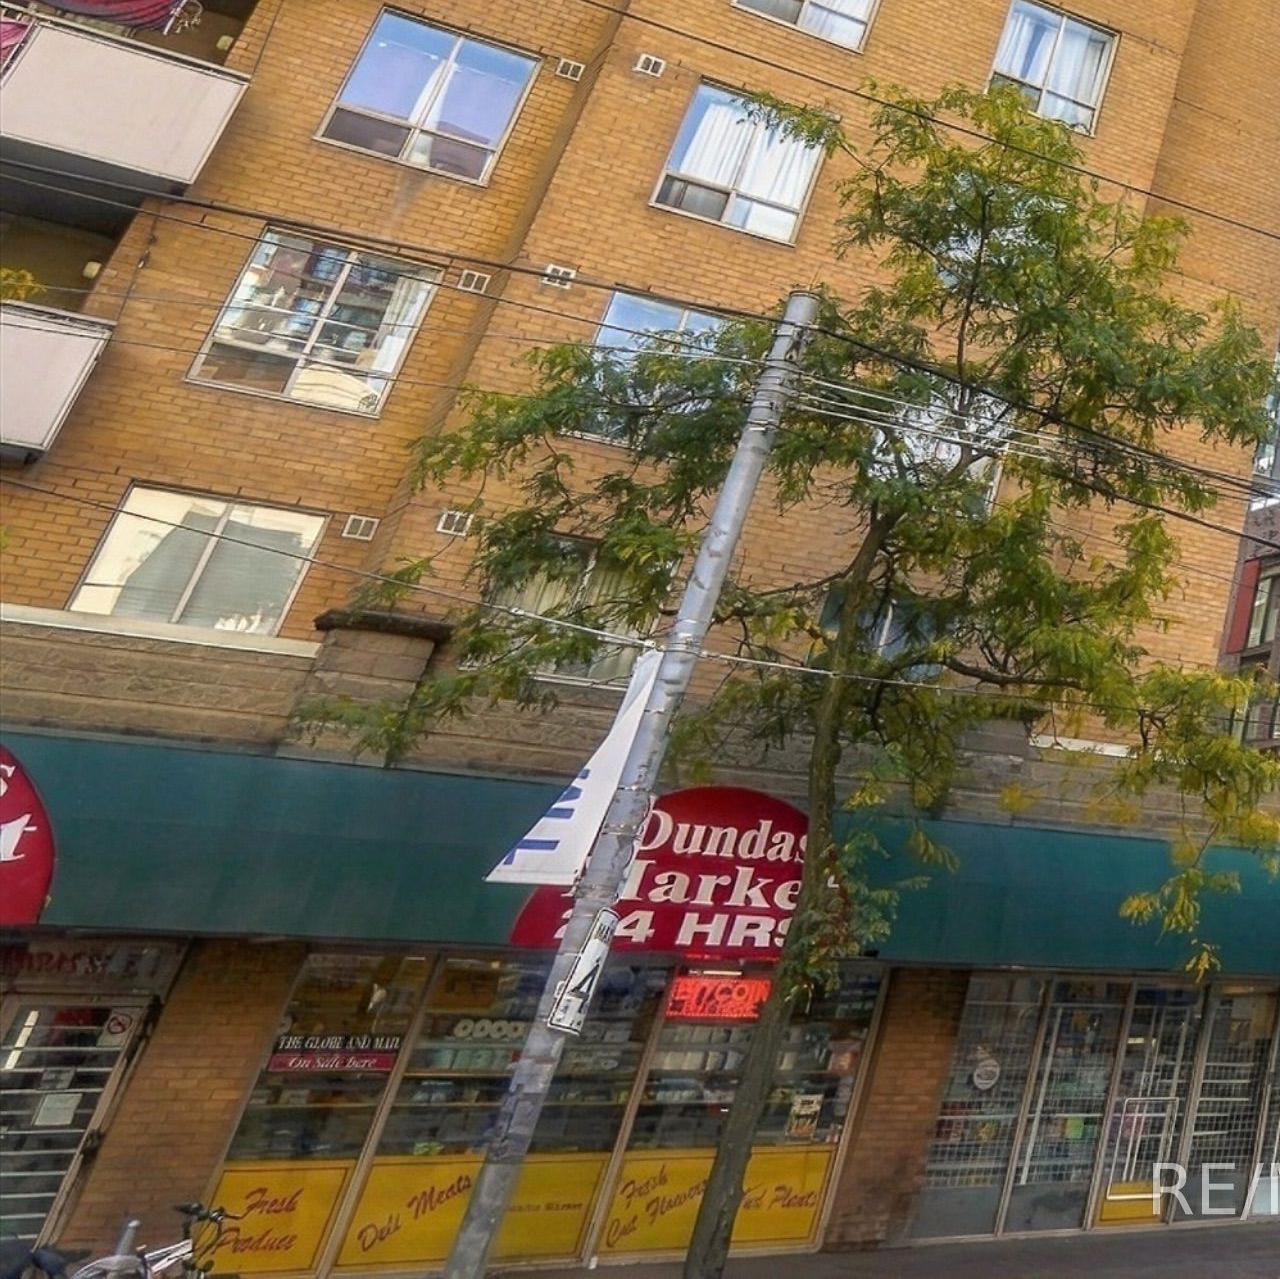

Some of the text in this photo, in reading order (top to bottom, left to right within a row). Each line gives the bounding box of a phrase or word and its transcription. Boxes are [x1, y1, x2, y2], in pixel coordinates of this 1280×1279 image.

[561, 859, 839, 910] arke
[278, 1035, 301, 1049] THE
[304, 1035, 345, 1049] GLOBE
[346, 1034, 371, 1049] AND
[288, 1056, 310, 1069] On
[245, 1187, 304, 1214] Fresh
[211, 1225, 298, 1255] Produce
